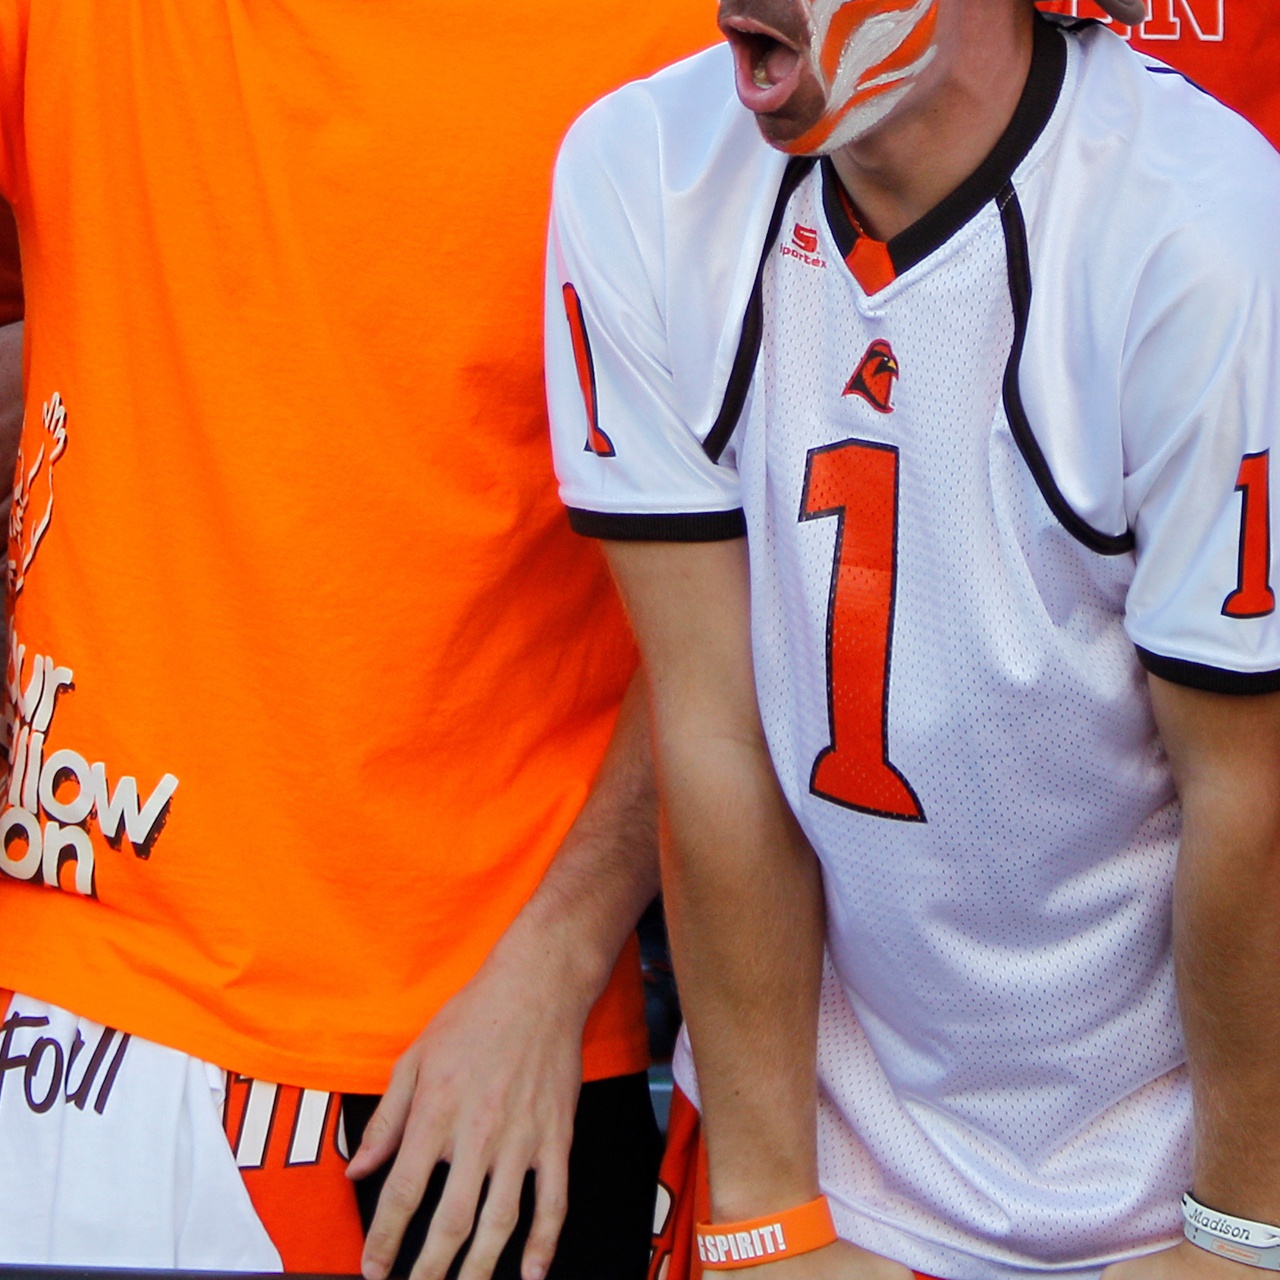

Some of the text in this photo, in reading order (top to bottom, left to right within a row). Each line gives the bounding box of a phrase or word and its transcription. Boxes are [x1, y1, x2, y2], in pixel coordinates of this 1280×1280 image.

[562, 281, 616, 458] 1
[1220, 449, 1276, 619] 1
[798, 438, 928, 824] 1
[705, 1222, 787, 1263] SPIRIT!
[1189, 1207, 1252, 1241] Madison
